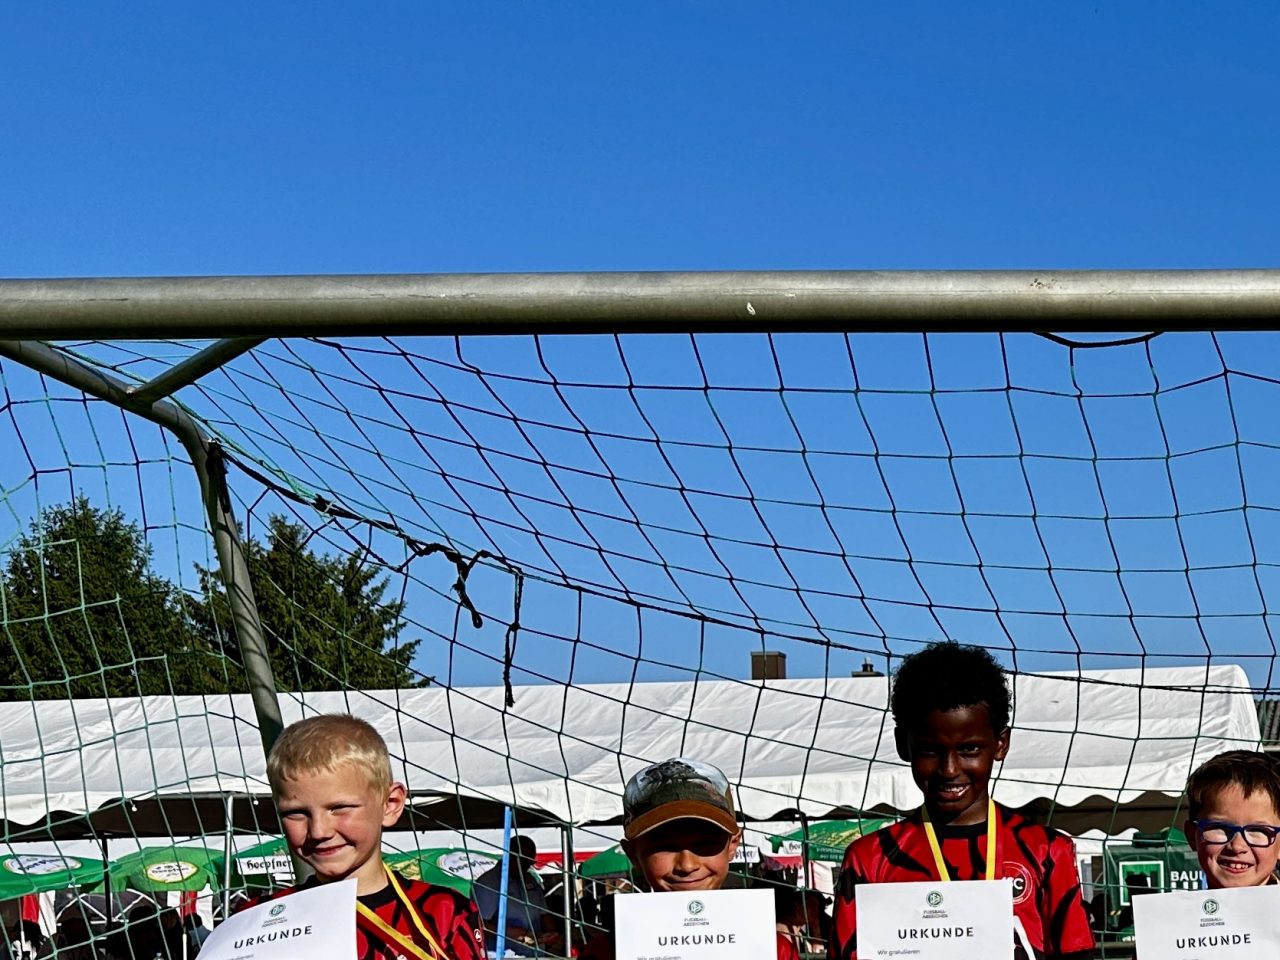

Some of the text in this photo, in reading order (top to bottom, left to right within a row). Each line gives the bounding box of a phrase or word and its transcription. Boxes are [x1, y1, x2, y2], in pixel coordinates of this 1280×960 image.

[234, 925, 313, 949] URKUNDE
[898, 927, 974, 939] URKUNDE
[658, 934, 736, 946] URKUNDE
[1176, 934, 1251, 949] URKUNDE
